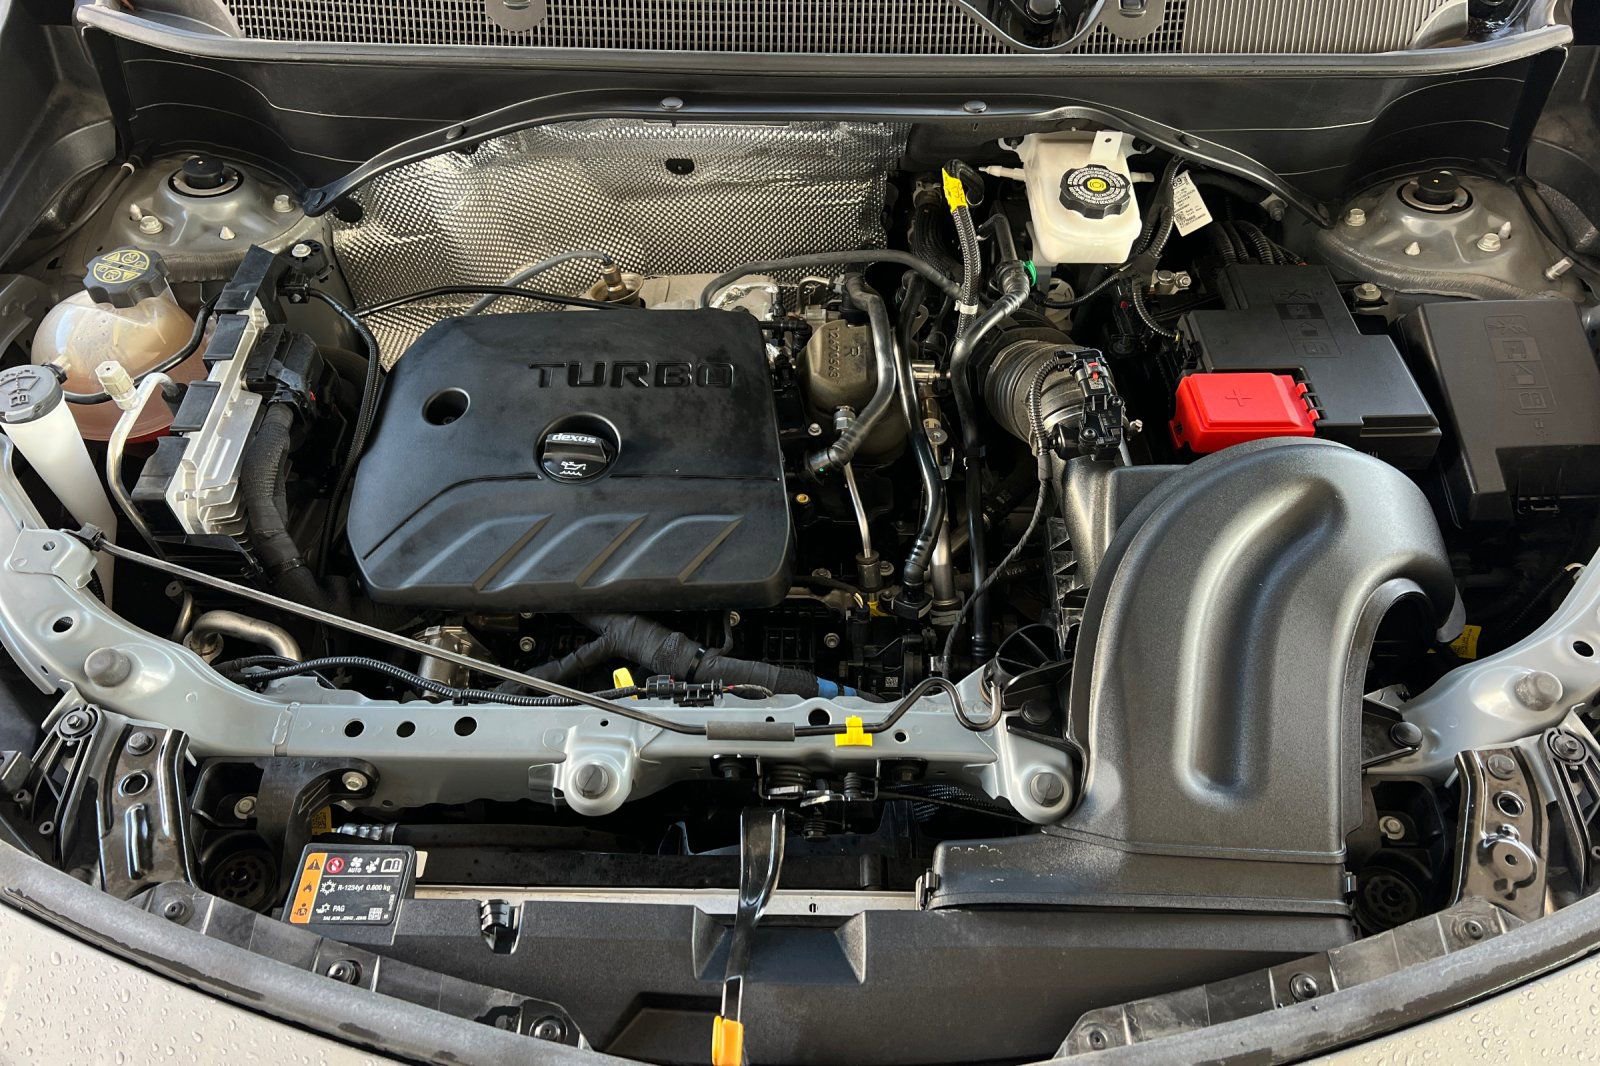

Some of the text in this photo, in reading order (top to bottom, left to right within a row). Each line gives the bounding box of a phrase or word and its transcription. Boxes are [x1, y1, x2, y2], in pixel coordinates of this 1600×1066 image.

[529, 361, 734, 388] TURBO
[552, 432, 597, 444] dexos
[383, 884, 391, 892] kg
[332, 905, 345, 913] PAG
